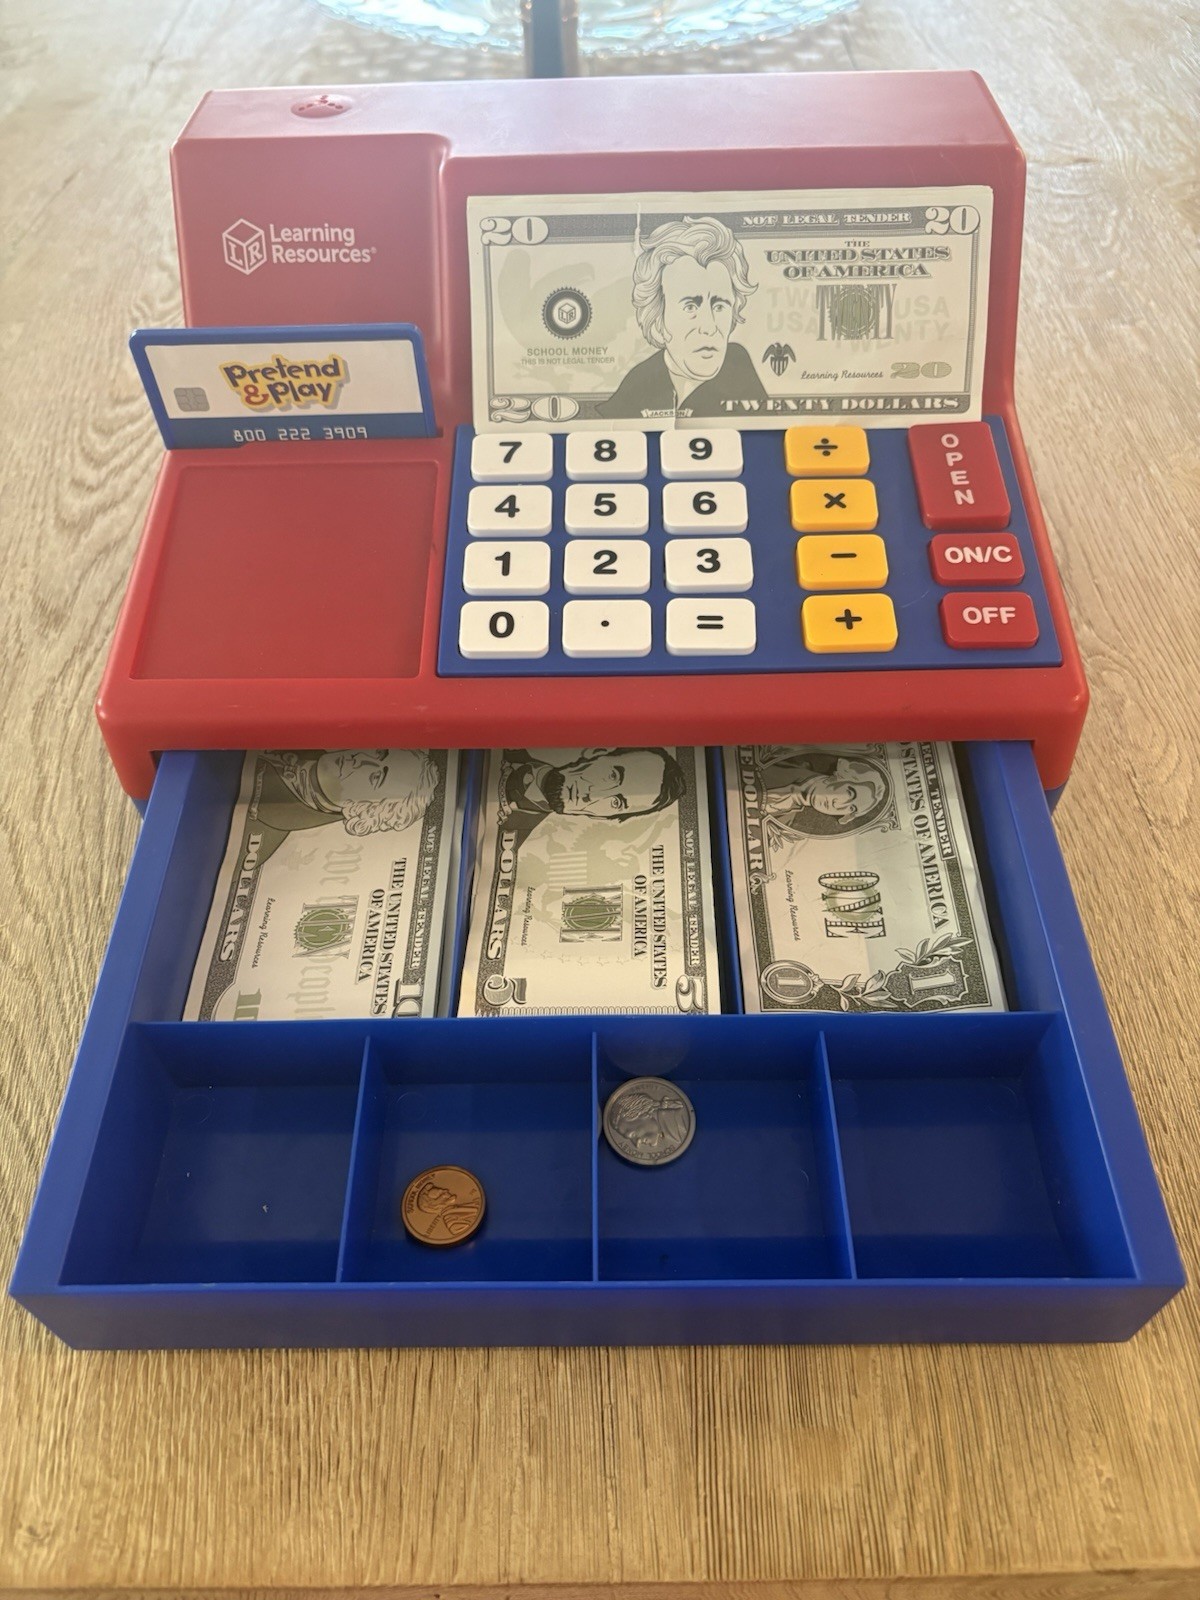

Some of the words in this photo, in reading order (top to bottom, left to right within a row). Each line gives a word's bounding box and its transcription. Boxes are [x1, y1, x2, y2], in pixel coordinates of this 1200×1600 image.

[480, 216, 549, 245] 20
[742, 215, 778, 227] NOT
[782, 213, 839, 226] LEGAL
[843, 211, 912, 225] TENDER
[924, 205, 980, 235] 20
[270, 224, 355, 246] Learning
[844, 239, 870, 248] THE
[765, 249, 857, 264] UNITED
[860, 245, 951, 262] STATES
[783, 265, 817, 280] OF
[816, 262, 931, 279] AMERICA
[526, 347, 569, 357] SCHOOL
[572, 346, 609, 357] MONEY
[546, 358, 561, 366] NOT
[562, 357, 585, 366] LEGAL
[587, 356, 615, 365] TENDER
[223, 357, 342, 388] Pretend
[801, 371, 838, 382] Learning
[840, 370, 883, 380] Resources
[890, 361, 952, 380] 20
[490, 395, 580, 422] 20
[720, 398, 836, 412] TWENTY
[841, 396, 960, 411] DOLLARS
[233, 429, 267, 442] 800
[278, 427, 311, 441] 222
[499, 442, 522, 463] 7
[593, 439, 617, 462] 8
[688, 438, 713, 460] 9
[941, 433, 975, 506] OPEN
[494, 494, 520, 518] 4
[593, 493, 617, 516] 5
[692, 491, 718, 515] 6
[494, 551, 511, 576] 1
[593, 550, 618, 575] 2
[696, 548, 721, 573] 3
[944, 545, 1013, 564] ON/C
[489, 611, 515, 638] 0
[962, 606, 1016, 625] OFF
[922, 742, 935, 786] EGAL
[901, 745, 928, 812] STATES
[741, 769, 764, 870] DOLLAR
[913, 814, 932, 840] OF
[927, 787, 953, 855] TENDER
[423, 825, 436, 852] NOT
[683, 830, 696, 856] NOT
[390, 857, 408, 889] THE
[651, 845, 665, 874] THE
[418, 856, 435, 905] LEGAL
[633, 875, 648, 896] OF
[684, 862, 698, 907] LEGAL
[784, 869, 798, 904] Learning
[914, 837, 950, 930] AMERICA
[218, 832, 263, 962] DOLLARS
[368, 887, 385, 910] OF
[486, 831, 518, 960] DOLLARS
[523, 886, 536, 914] Learning
[651, 879, 667, 931] UNITED
[818, 870, 887, 939] ONE
[258, 897, 276, 931] Learning
[380, 890, 403, 950] UNITED
[632, 896, 648, 958] AMERICA
[788, 904, 802, 941] Resources
[409, 909, 431, 970] TENDER
[521, 914, 531, 946] Resources
[688, 915, 702, 965] TENDER
[251, 931, 268, 968] Resources
[356, 908, 378, 983] AMERICA
[652, 931, 668, 989] STATES
[371, 951, 394, 1016] STATES
[483, 974, 527, 1006] 5
[676, 974, 704, 1013] 5
[775, 973, 807, 989] 1
[908, 970, 956, 996] 1
